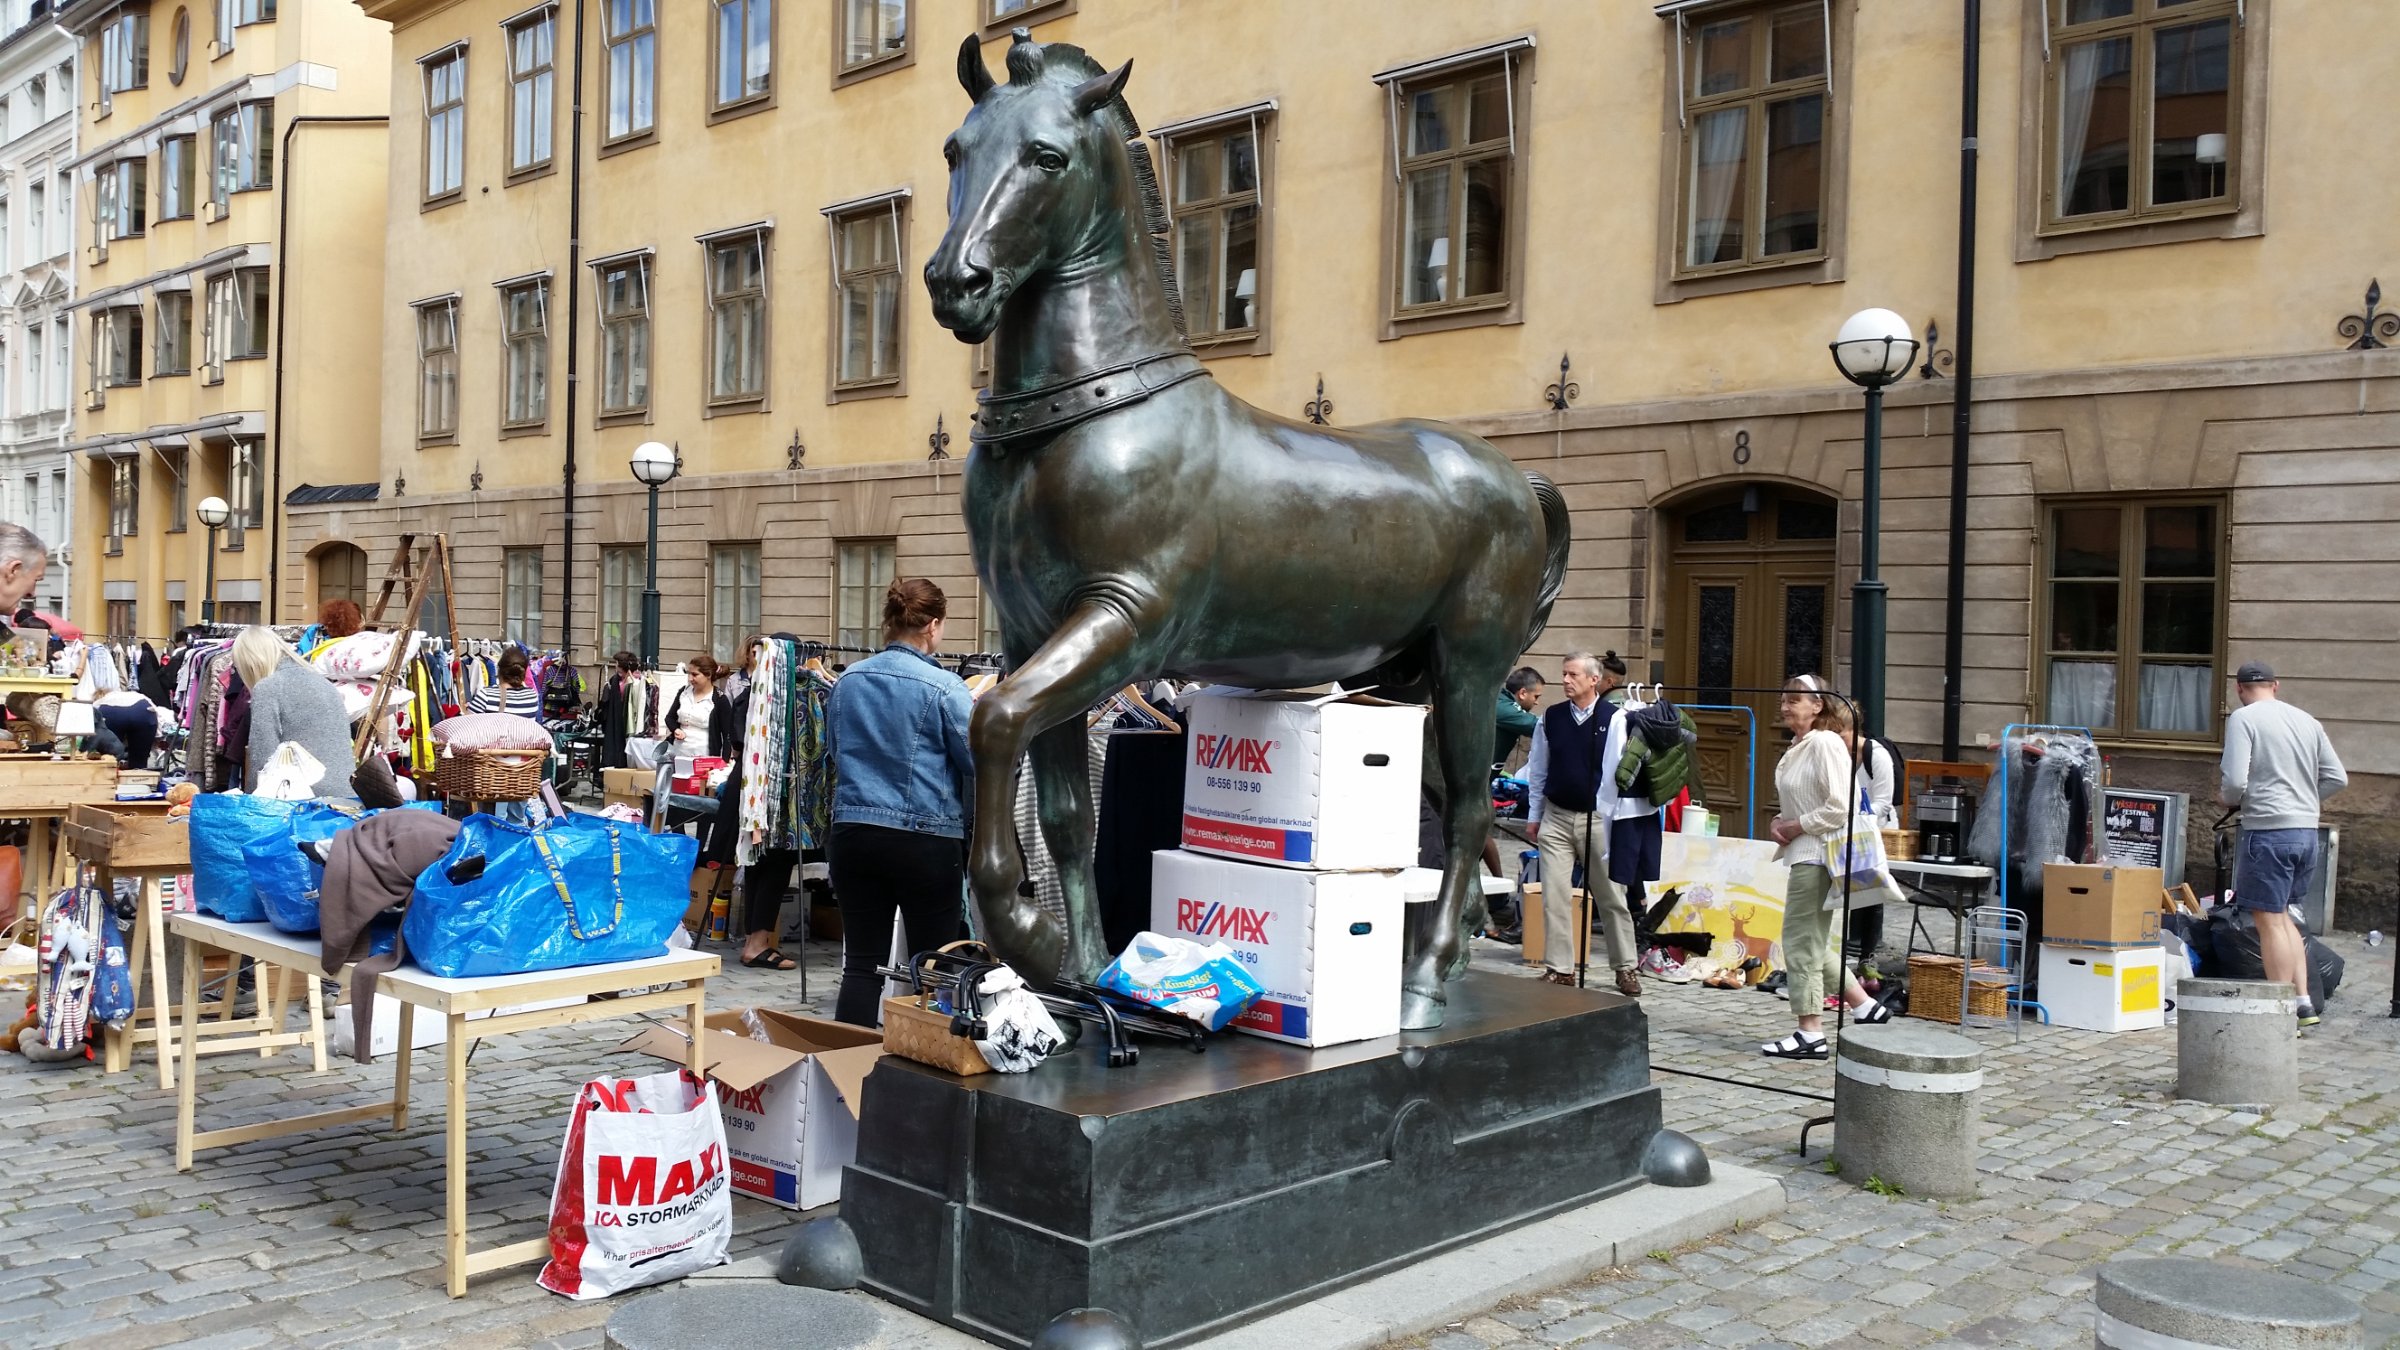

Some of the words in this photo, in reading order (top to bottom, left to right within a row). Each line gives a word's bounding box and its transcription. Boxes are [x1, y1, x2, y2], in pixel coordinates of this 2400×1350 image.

[1733, 430, 1751, 465] 8
[1195, 733, 1272, 774] RE/MAX
[1206, 776, 1231, 790] 08-556
[1234, 780, 1249, 792] 139
[1250, 782, 1262, 793] 90
[2122, 809, 2150, 817] FESTIVAL
[1258, 816, 1278, 825] global
[1279, 818, 1312, 828] marknad
[1177, 897, 1270, 945] RE/MAX
[1246, 952, 1258, 964] 90
[1277, 991, 1307, 1003] marknad
[728, 1115, 742, 1129] 139
[745, 1119, 755, 1132] 90
[750, 1153, 769, 1164] global
[769, 1159, 796, 1171] marknad
[597, 1141, 723, 1206] MAXI
[594, 1210, 623, 1228] ICA
[626, 1176, 725, 1227] STORMARKNAD
[612, 1250, 627, 1261] har
